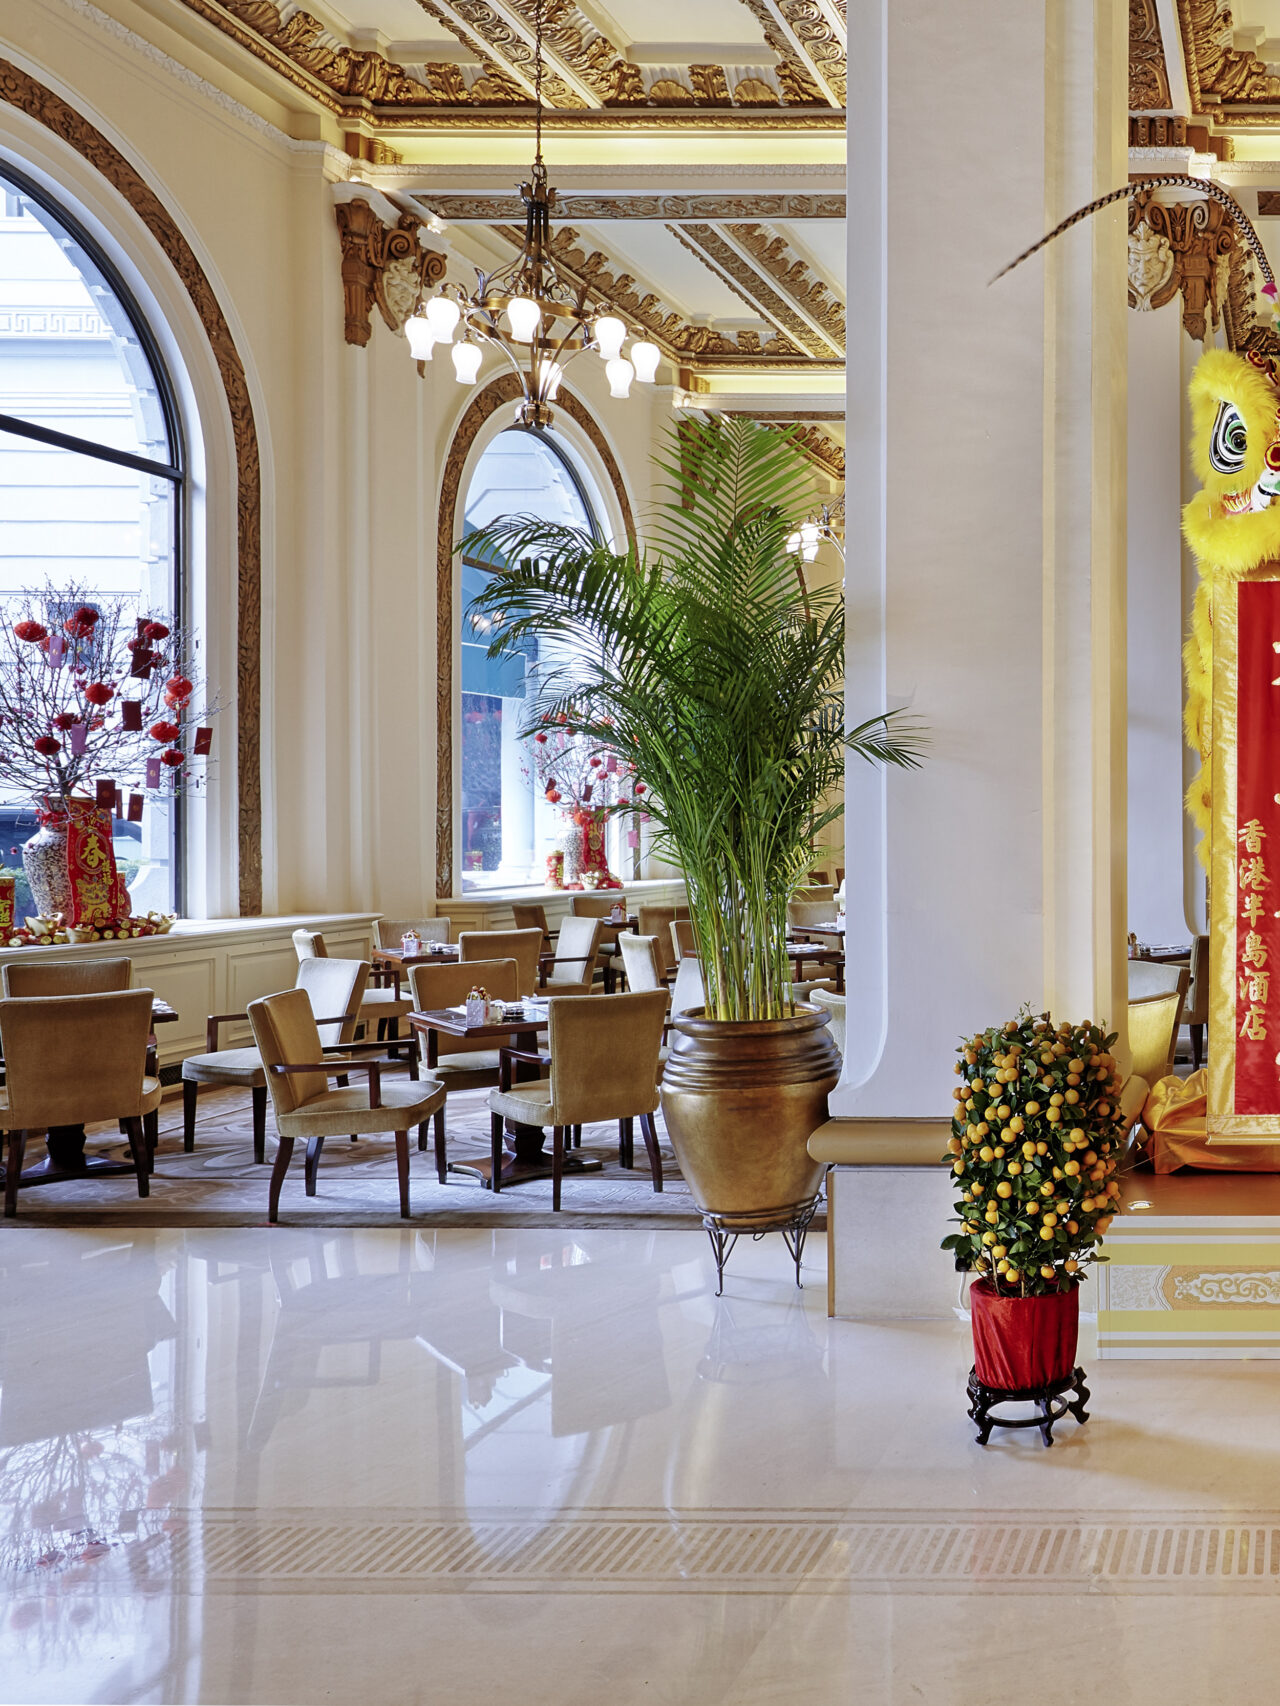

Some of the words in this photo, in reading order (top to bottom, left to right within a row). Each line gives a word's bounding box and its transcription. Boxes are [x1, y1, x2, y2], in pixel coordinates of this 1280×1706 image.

[1237, 818, 1272, 1041] 香港半島酒店
